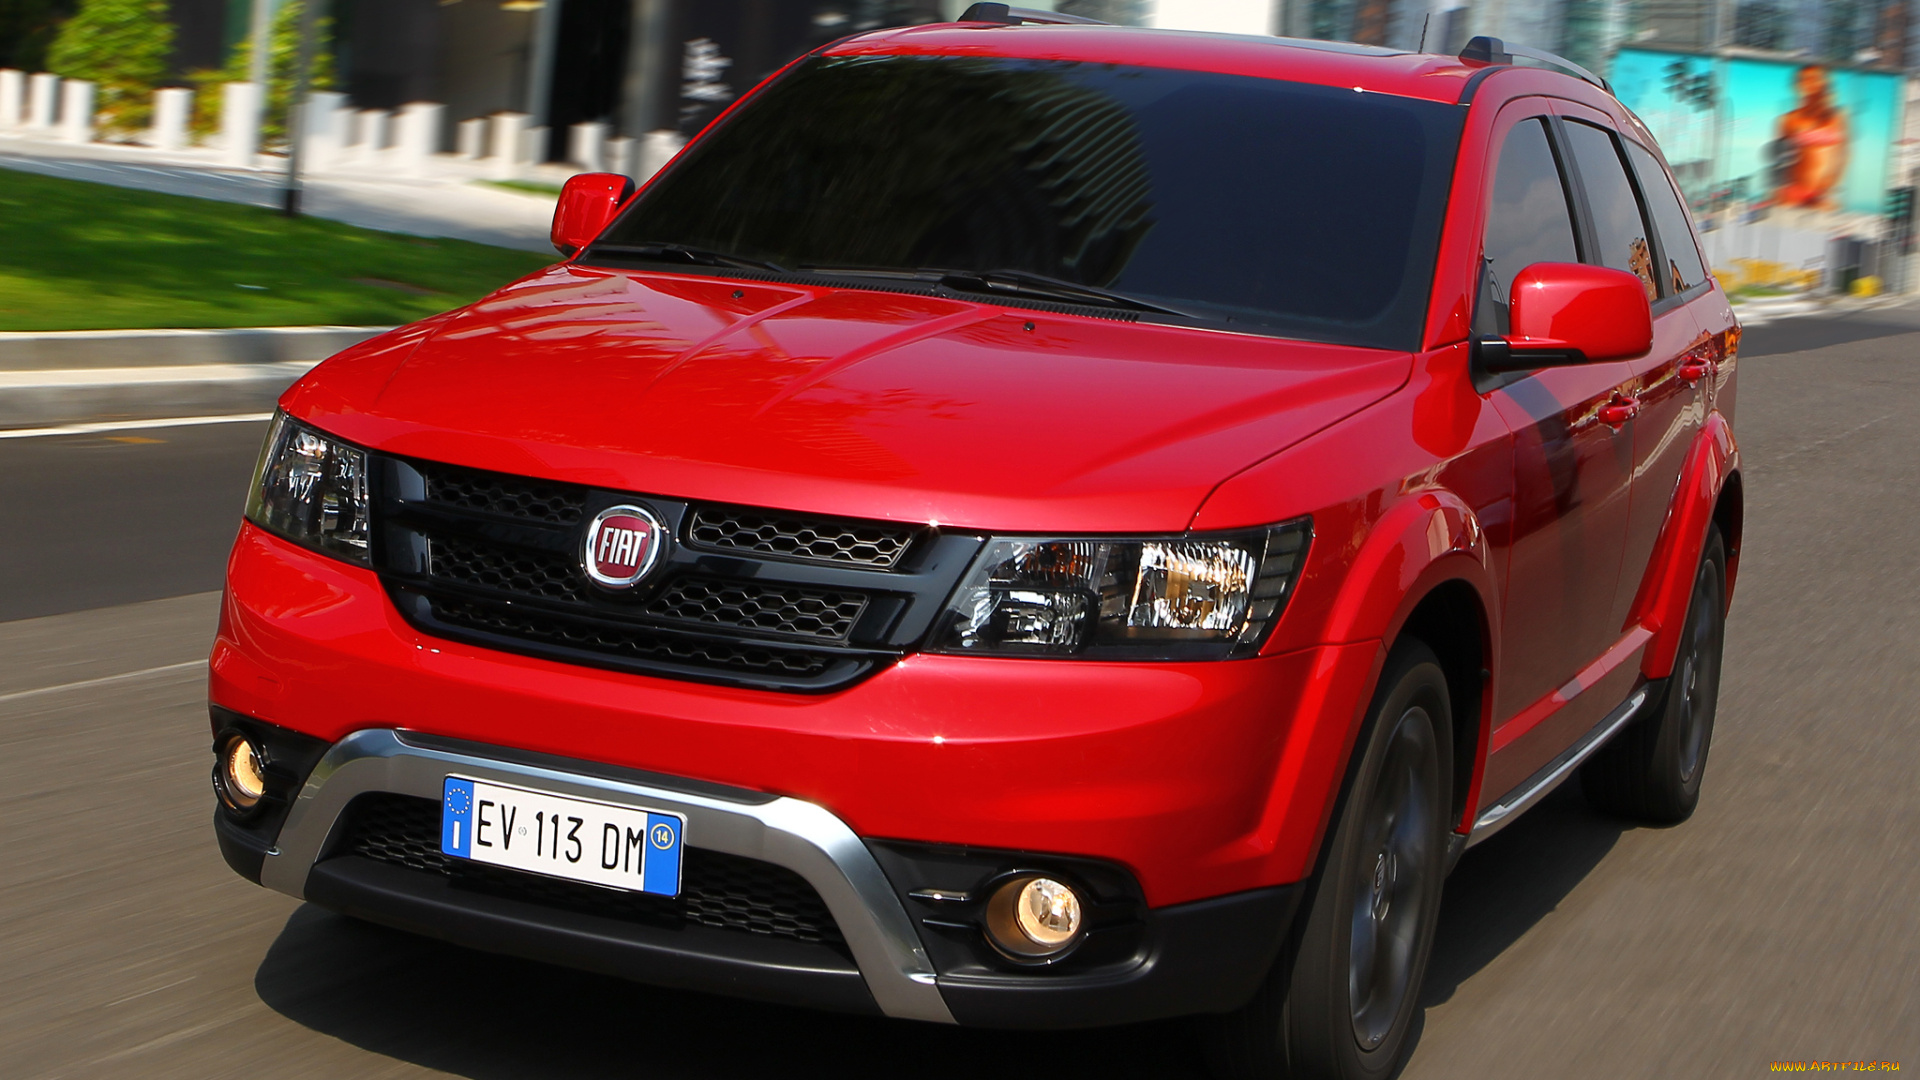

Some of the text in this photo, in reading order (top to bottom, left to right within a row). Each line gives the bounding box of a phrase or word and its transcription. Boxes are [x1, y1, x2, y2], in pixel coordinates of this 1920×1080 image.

[598, 526, 647, 567] FIAT
[477, 800, 645, 876] EV 113 DM
[656, 829, 669, 844] 14
